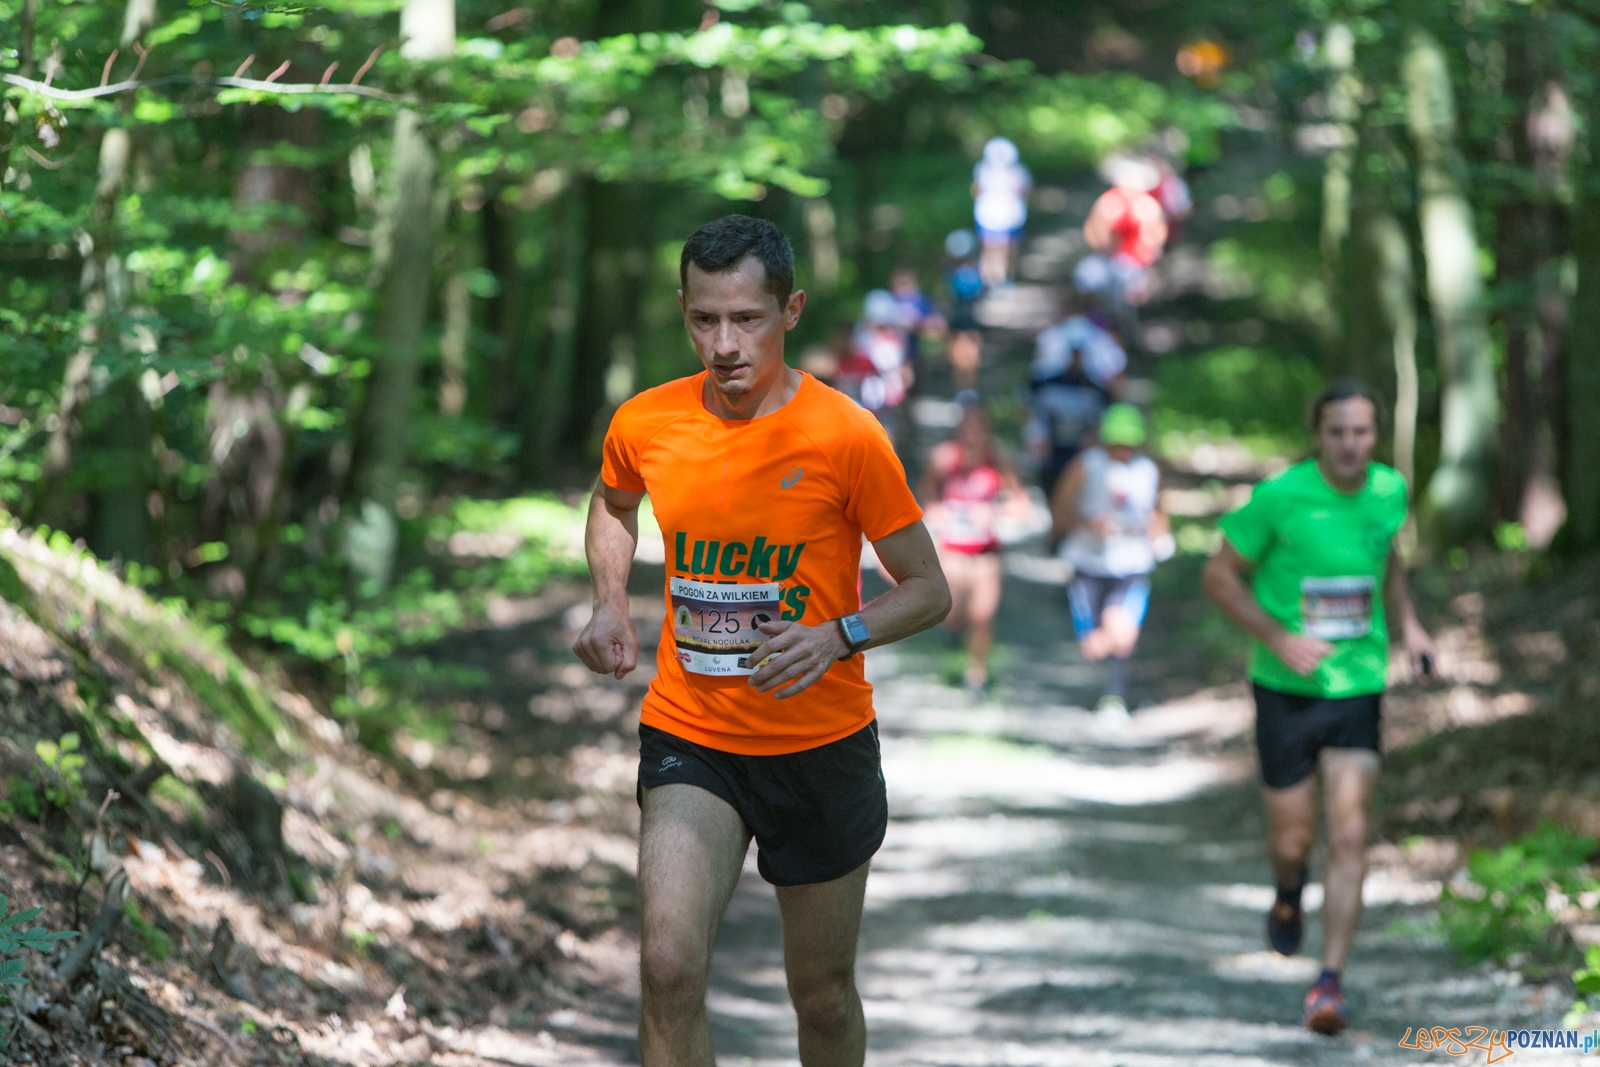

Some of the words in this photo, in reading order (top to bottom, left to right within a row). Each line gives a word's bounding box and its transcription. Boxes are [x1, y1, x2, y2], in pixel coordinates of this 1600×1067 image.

[675, 531, 806, 582] Lucky
[678, 584, 704, 599] POGOŃ
[706, 590, 719, 600] ZA
[721, 590, 769, 601] WILKIEM
[697, 608, 740, 634] 125
